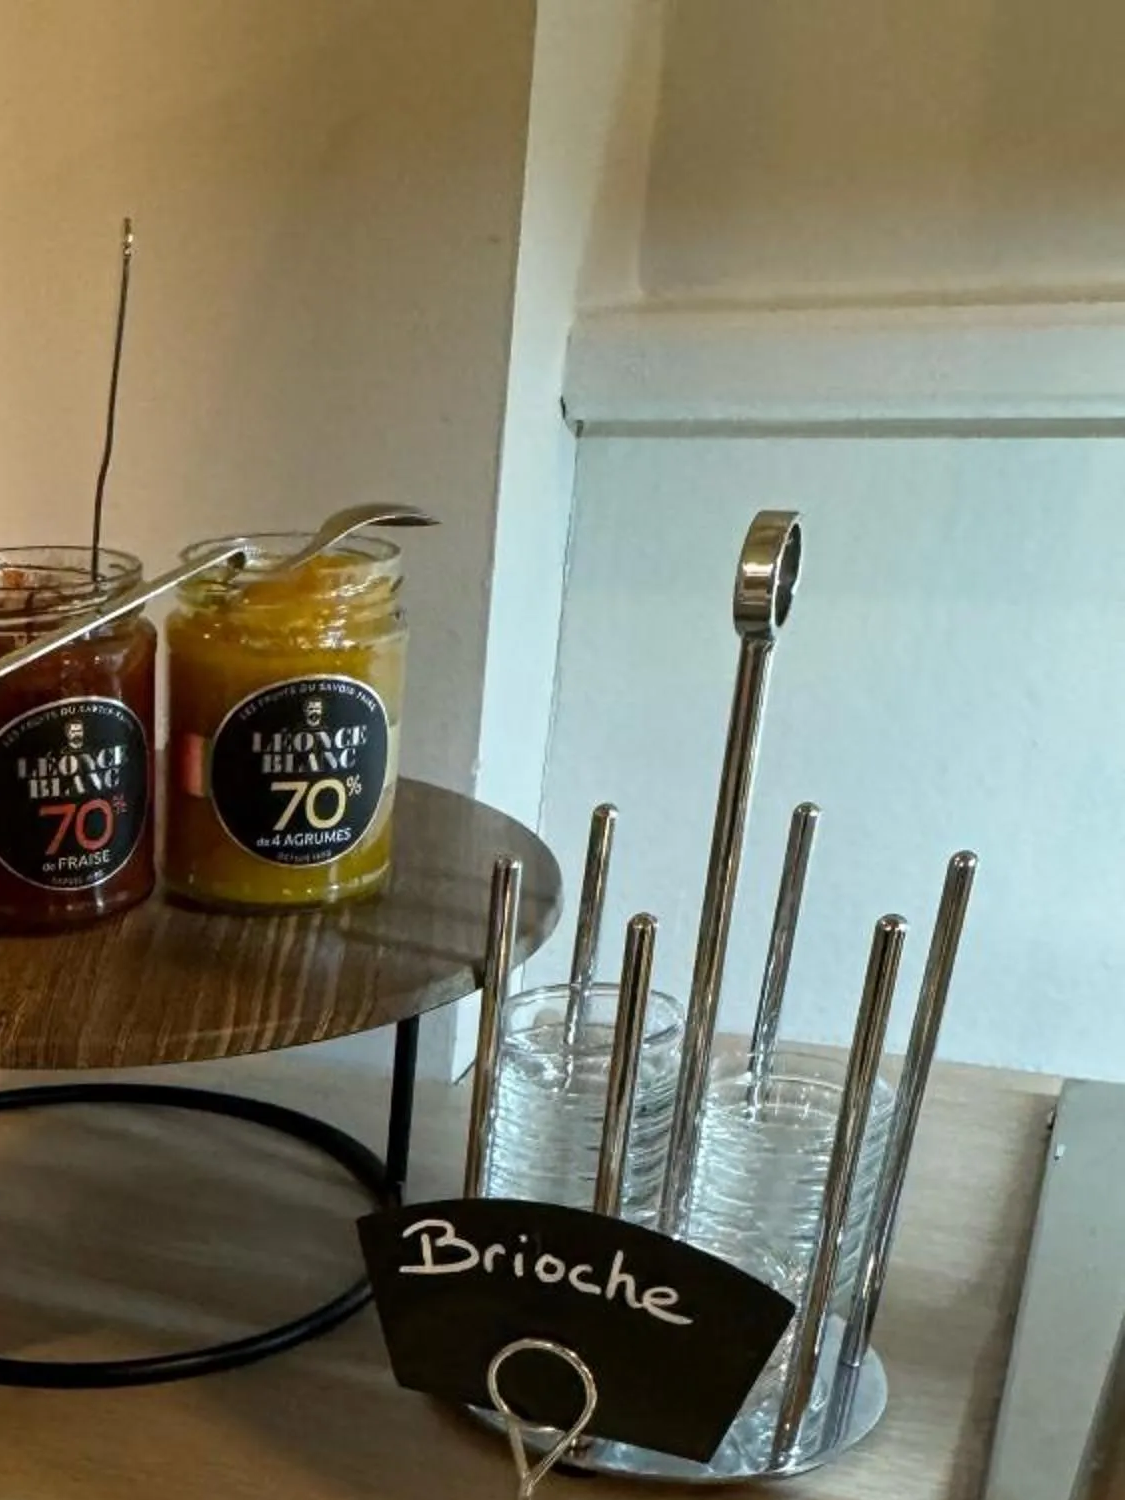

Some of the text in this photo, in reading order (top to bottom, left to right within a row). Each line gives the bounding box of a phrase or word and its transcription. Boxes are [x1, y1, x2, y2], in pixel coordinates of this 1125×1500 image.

[261, 748, 356, 774] BLANC
[29, 768, 121, 798] BLANC
[271, 834, 281, 847] 4
[282, 828, 352, 847] AGRUMES
[58, 849, 112, 871] FRAISE
[398, 1217, 694, 1326] Brioche
